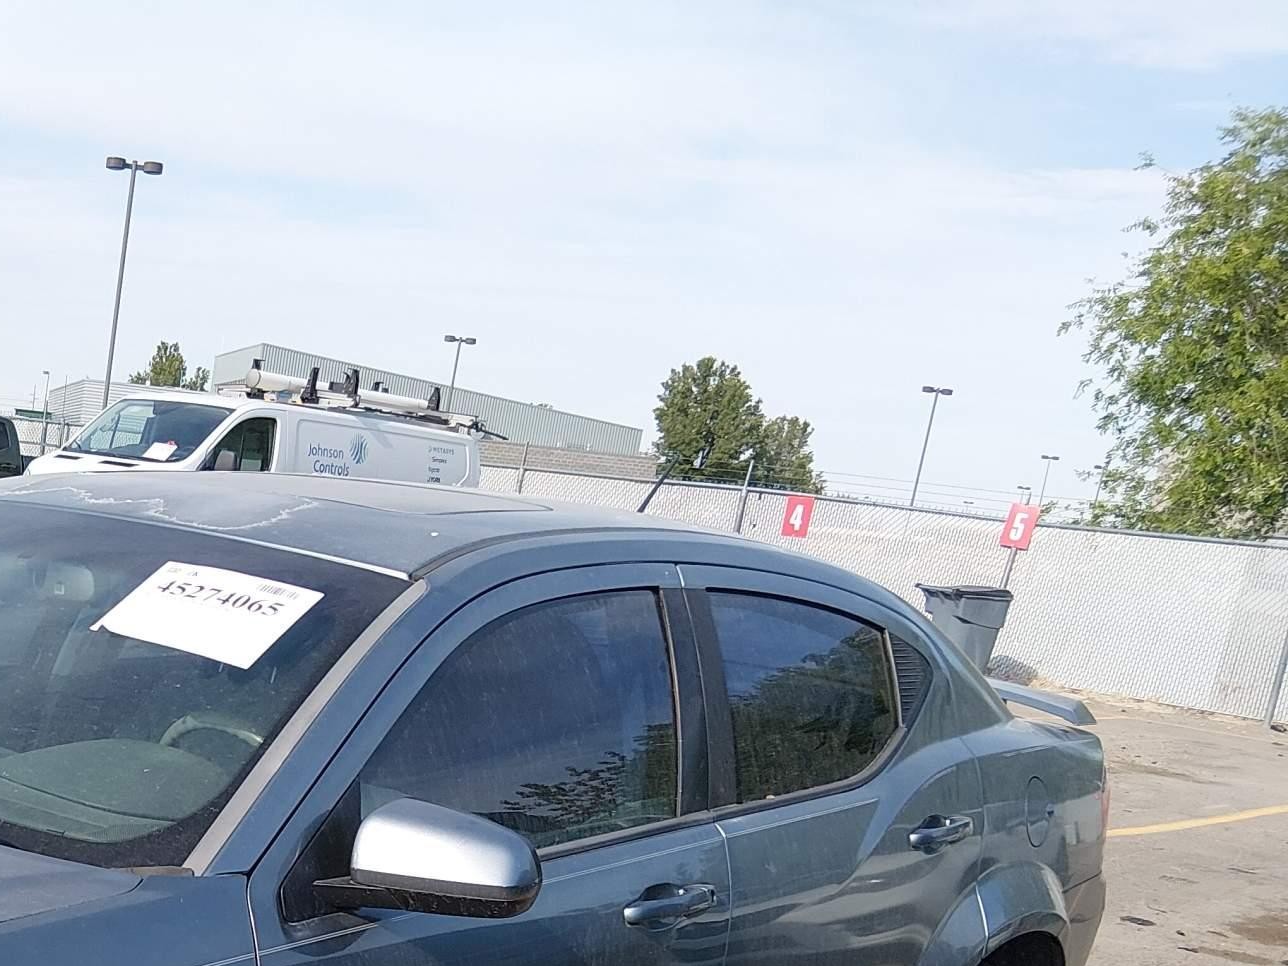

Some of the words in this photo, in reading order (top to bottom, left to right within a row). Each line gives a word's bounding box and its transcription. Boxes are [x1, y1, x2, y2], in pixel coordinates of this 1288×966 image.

[308, 443, 344, 459] Johnson
[313, 460, 349, 477] Controls
[789, 504, 804, 531] 4
[1008, 512, 1029, 541] 5
[157, 580, 285, 616] 45274065
